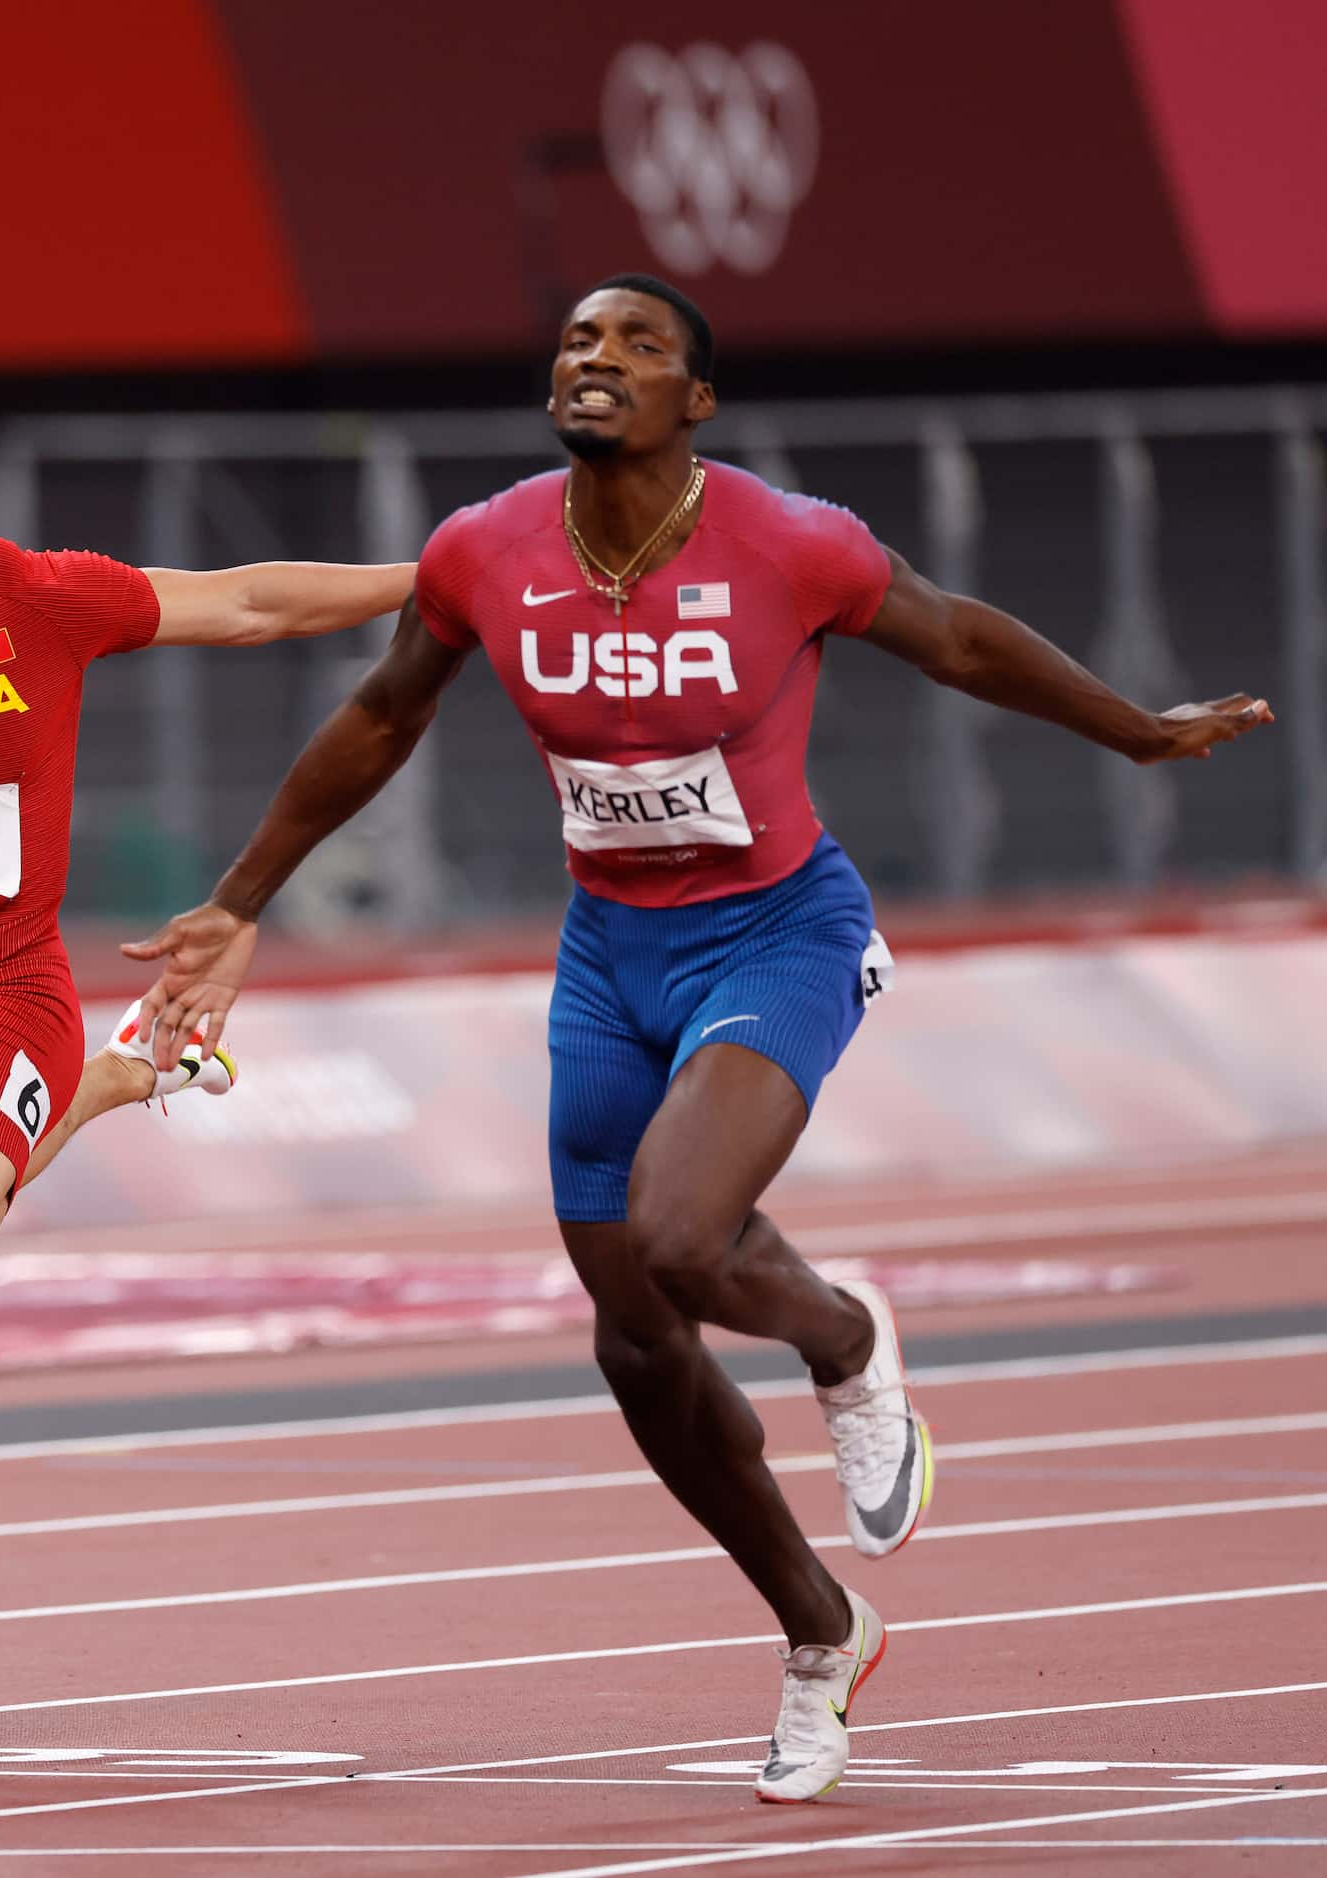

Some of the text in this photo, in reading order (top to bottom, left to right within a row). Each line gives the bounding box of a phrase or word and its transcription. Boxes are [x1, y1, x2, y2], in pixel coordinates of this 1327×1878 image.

[520, 629, 738, 698] USA
[567, 776, 714, 824] KERLEY
[17, 1078, 42, 1138] 6
